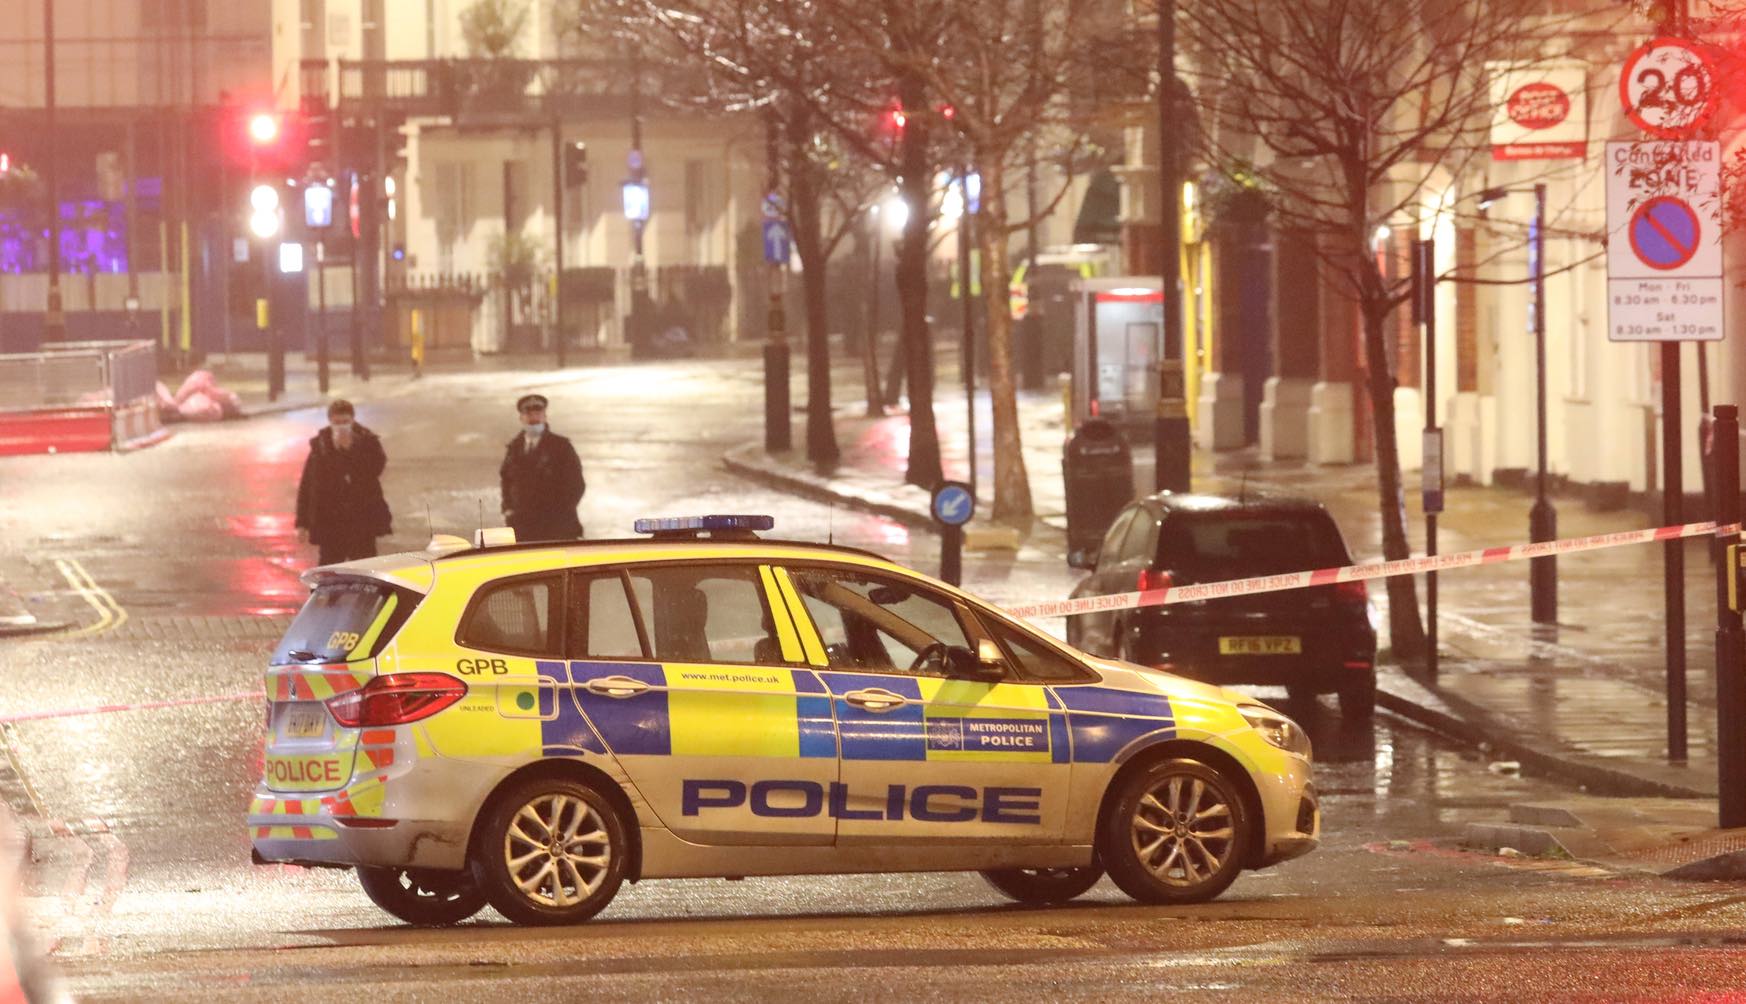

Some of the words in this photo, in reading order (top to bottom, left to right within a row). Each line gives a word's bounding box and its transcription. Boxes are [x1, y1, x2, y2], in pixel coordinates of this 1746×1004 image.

[1637, 67, 1706, 107] 20
[1638, 282, 1662, 291] Mon
[1675, 282, 1690, 291] Fri
[1656, 312, 1674, 322] Sat
[327, 631, 359, 651] GPB
[456, 658, 508, 675] GPB
[681, 672, 779, 683] www.met.police.uk
[969, 723, 1042, 733] METROPOLITAN
[981, 735, 1033, 746] POLICE
[267, 759, 341, 782] POLICE
[682, 780, 1042, 825] POLICE
